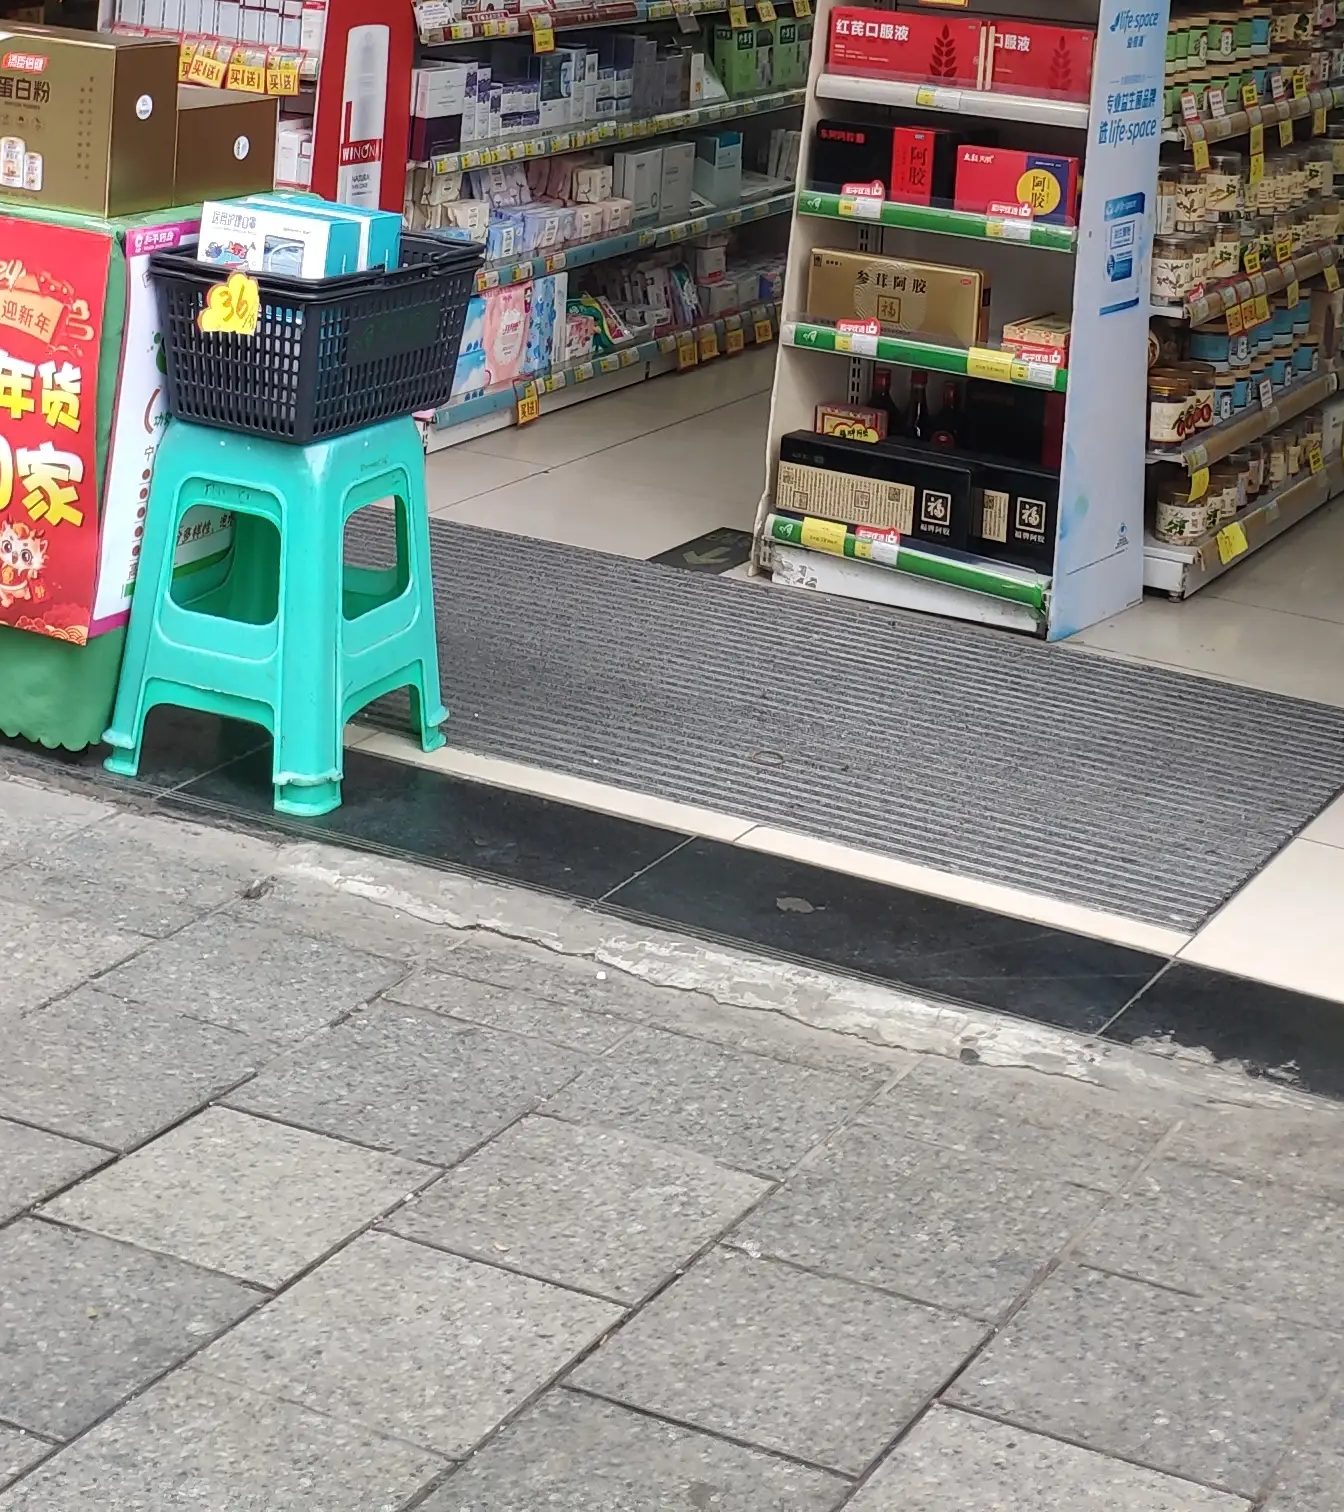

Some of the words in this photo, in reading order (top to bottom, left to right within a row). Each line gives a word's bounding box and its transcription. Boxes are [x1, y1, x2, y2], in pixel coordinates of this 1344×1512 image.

[835, 17, 909, 42] 红芪口服液
[230, 69, 261, 87] 买1送1
[269, 75, 297, 90] 买1送1
[1106, 90, 1157, 114] 专业益生菌品牌
[908, 146, 927, 187] 阿胶
[1030, 175, 1046, 209] 阿胶
[856, 269, 927, 294] 参茸阿胶
